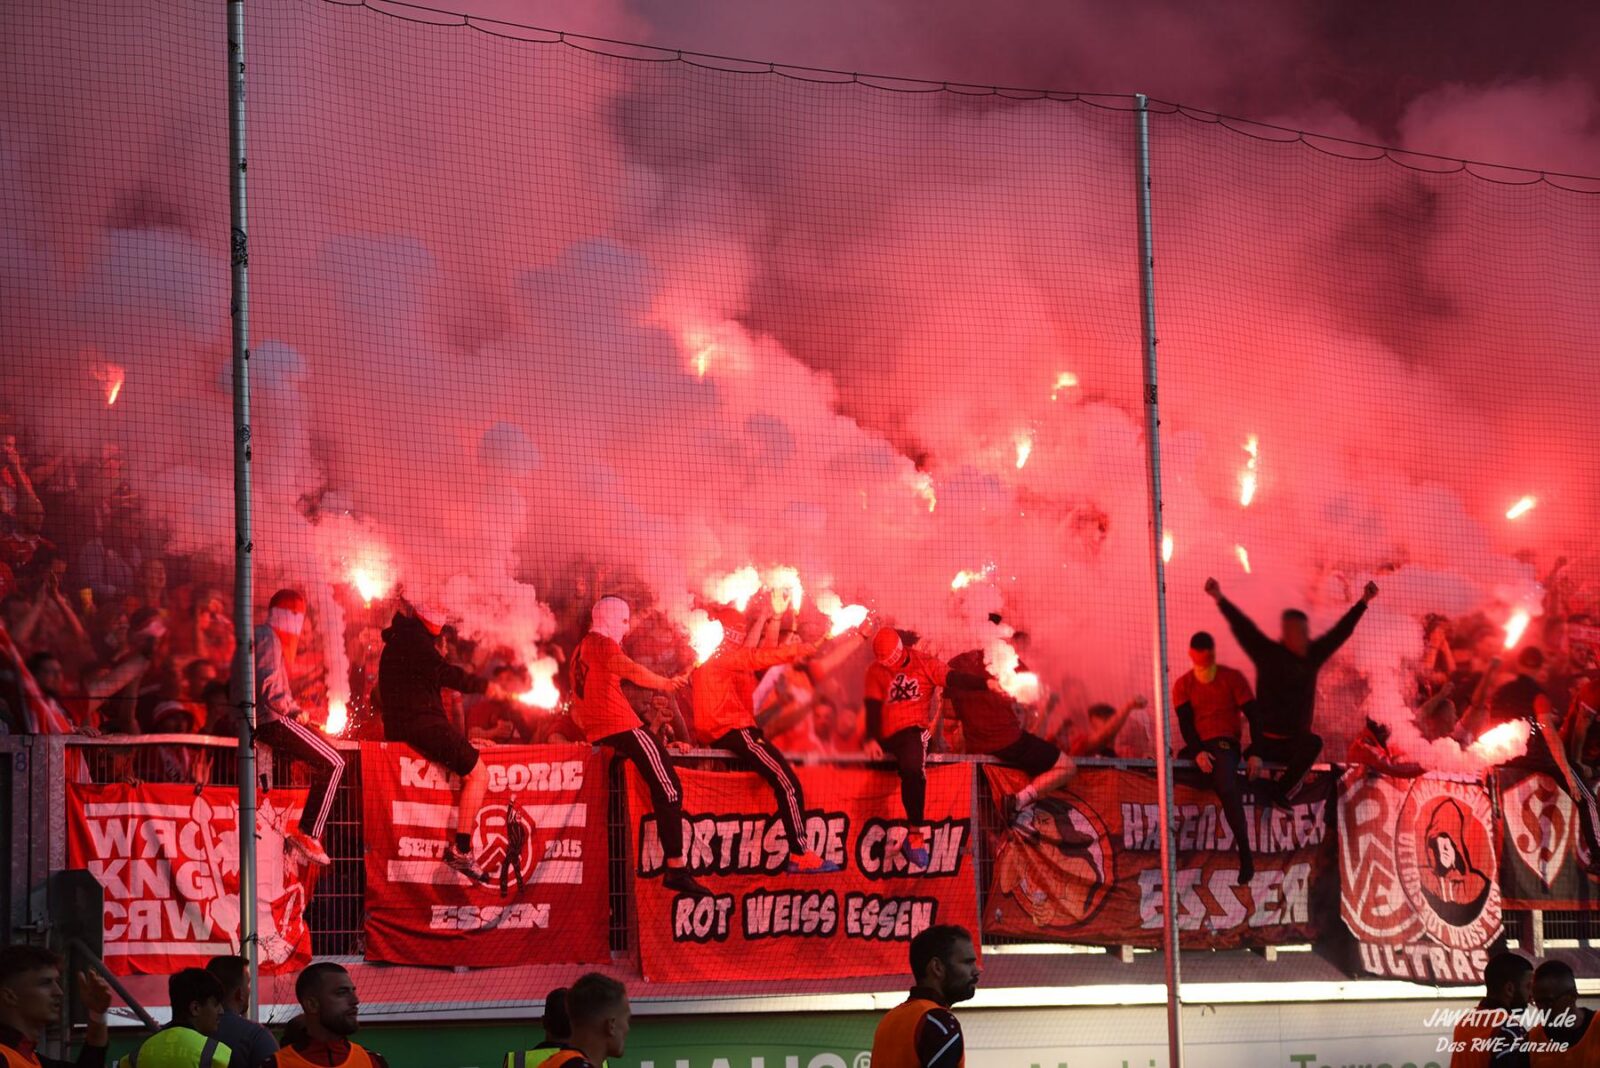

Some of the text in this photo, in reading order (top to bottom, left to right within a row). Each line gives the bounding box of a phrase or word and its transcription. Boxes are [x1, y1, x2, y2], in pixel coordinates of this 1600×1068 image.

[400, 757, 584, 792] KAGORIE
[641, 816, 846, 873] NRTHSDE
[430, 903, 550, 929] ESSEN
[675, 894, 933, 940] ROT WEISS ESSEN
[1359, 942, 1489, 981] ULTRAS
